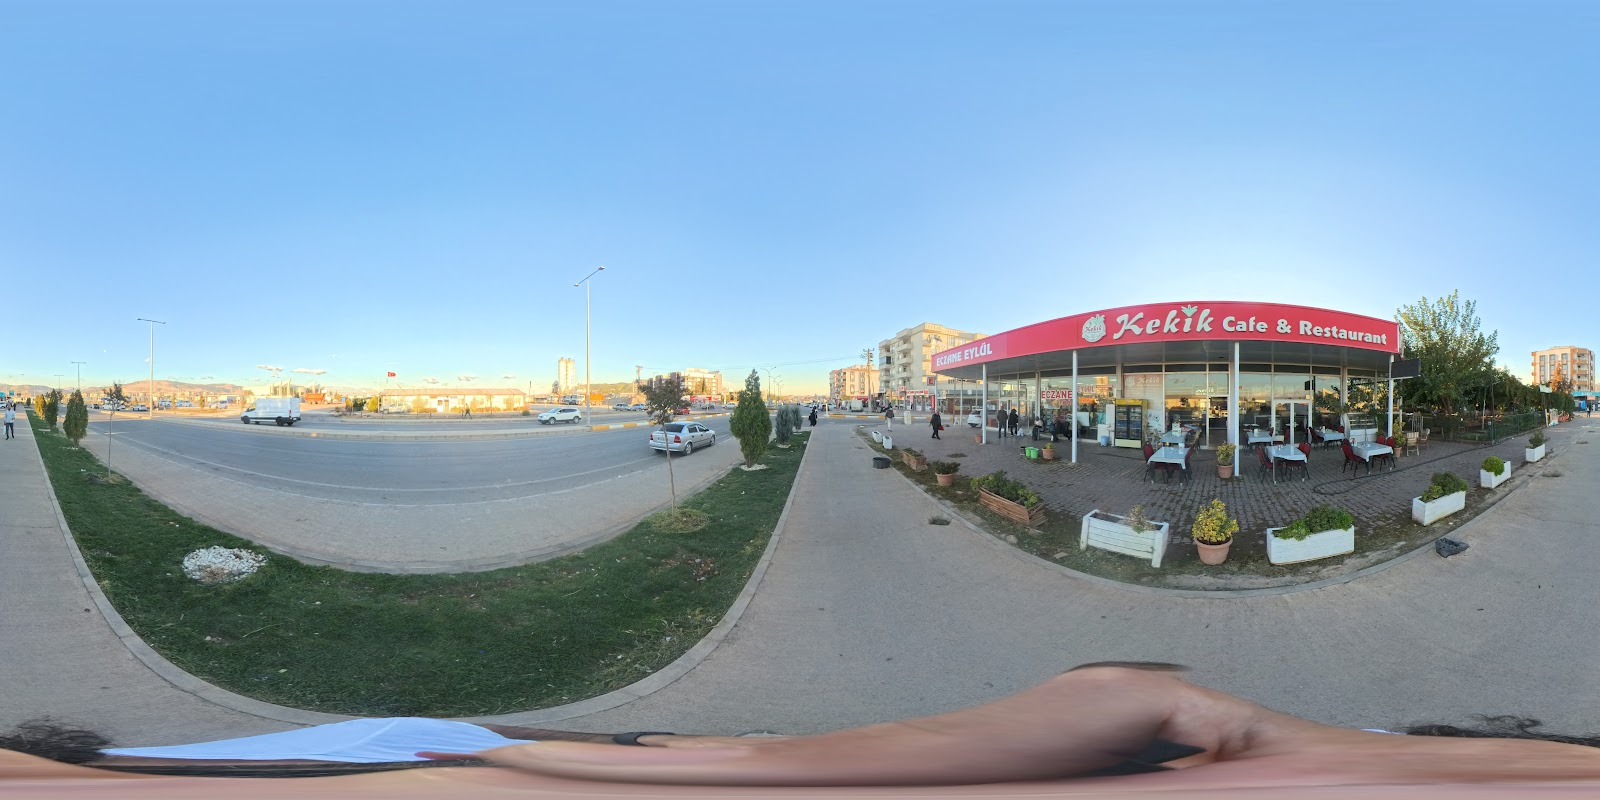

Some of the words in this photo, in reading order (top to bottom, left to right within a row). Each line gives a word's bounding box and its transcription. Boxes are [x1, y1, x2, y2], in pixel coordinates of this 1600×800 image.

[1112, 306, 1214, 340] Kekik
[1222, 316, 1268, 333] Cafe
[1276, 318, 1292, 334] &
[1299, 320, 1387, 345] Restaurant
[936, 351, 962, 367] ECZANE
[964, 342, 993, 360] EYLÜL
[1041, 390, 1073, 399] ECZANE
